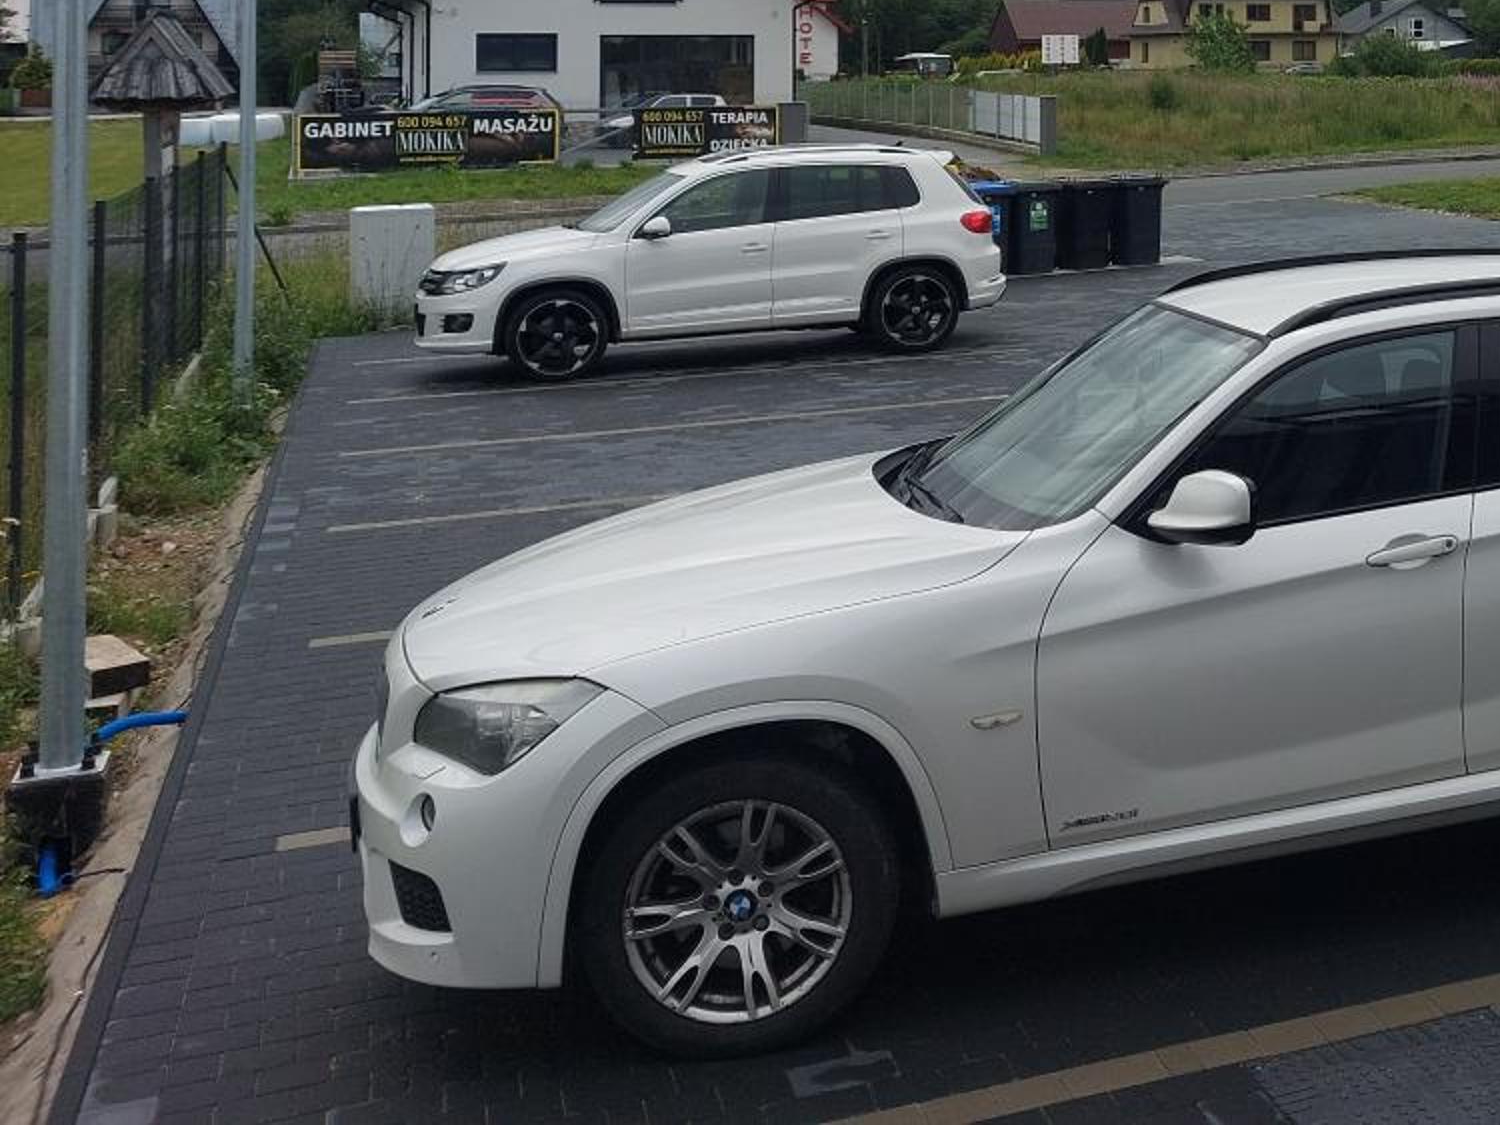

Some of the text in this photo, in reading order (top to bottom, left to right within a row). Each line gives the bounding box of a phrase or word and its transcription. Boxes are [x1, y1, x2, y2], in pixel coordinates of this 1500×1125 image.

[473, 114, 554, 134] MASAŻU
[710, 111, 769, 124] TERAPIA
[304, 121, 395, 138] GABINET
[645, 124, 702, 145] MOKIKA
[399, 130, 465, 153] MOKIKA
